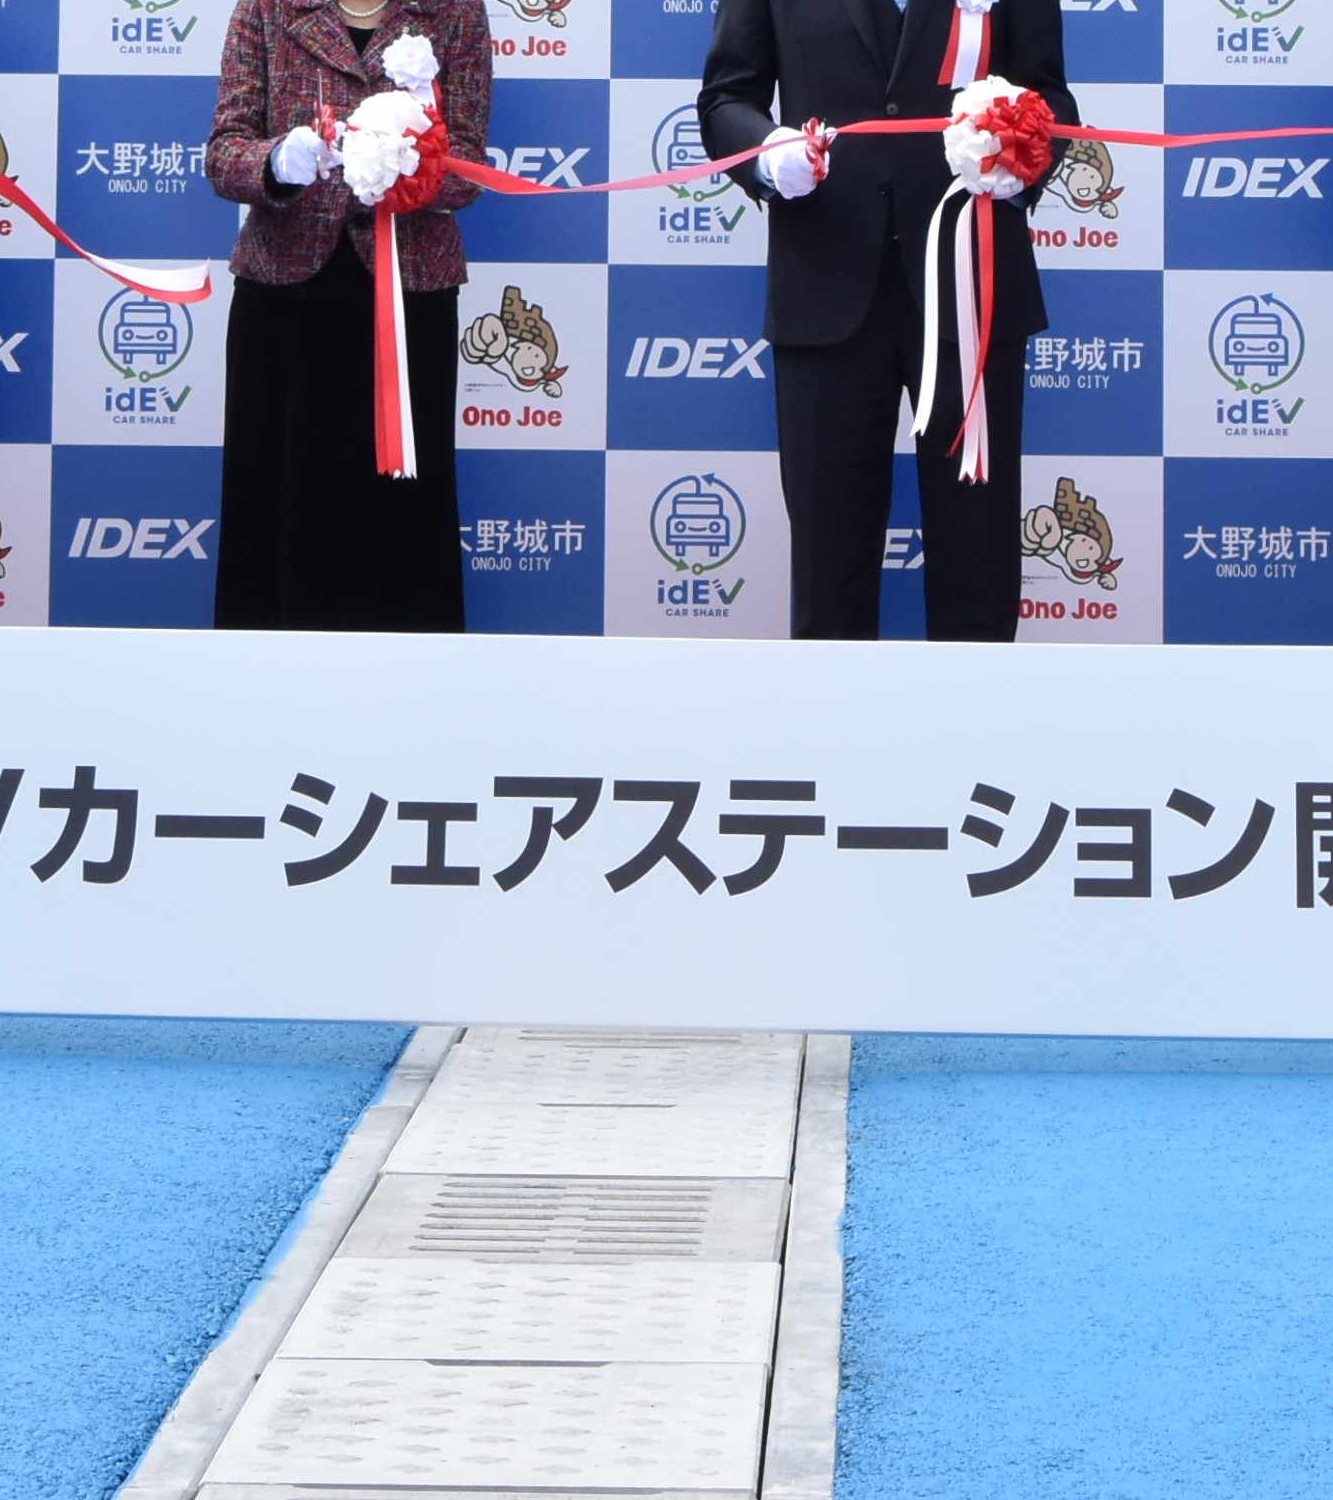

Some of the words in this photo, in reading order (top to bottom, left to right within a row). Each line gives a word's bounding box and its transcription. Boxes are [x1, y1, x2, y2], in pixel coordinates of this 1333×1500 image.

[523, 36, 566, 56] Joe
[1253, 56, 1288, 64] SHARE
[109, 179, 148, 192] ONOJO
[156, 180, 187, 193] CITY
[1182, 158, 1329, 198] IDEX
[1075, 228, 1118, 247] Joe
[626, 338, 769, 378] IDEX
[140, 416, 175, 424] SHARE
[463, 405, 512, 427] Ono
[519, 406, 563, 427] Joe
[1226, 428, 1247, 436] CAR
[1253, 428, 1288, 436] SHARE
[69, 518, 215, 559] IDEX
[1184, 526, 1330, 561] 大野城市
[1216, 564, 1256, 577] ONOJO
[1265, 564, 1296, 577] CITY
[1019, 598, 1067, 620] Ono
[1072, 599, 1118, 620] Joe
